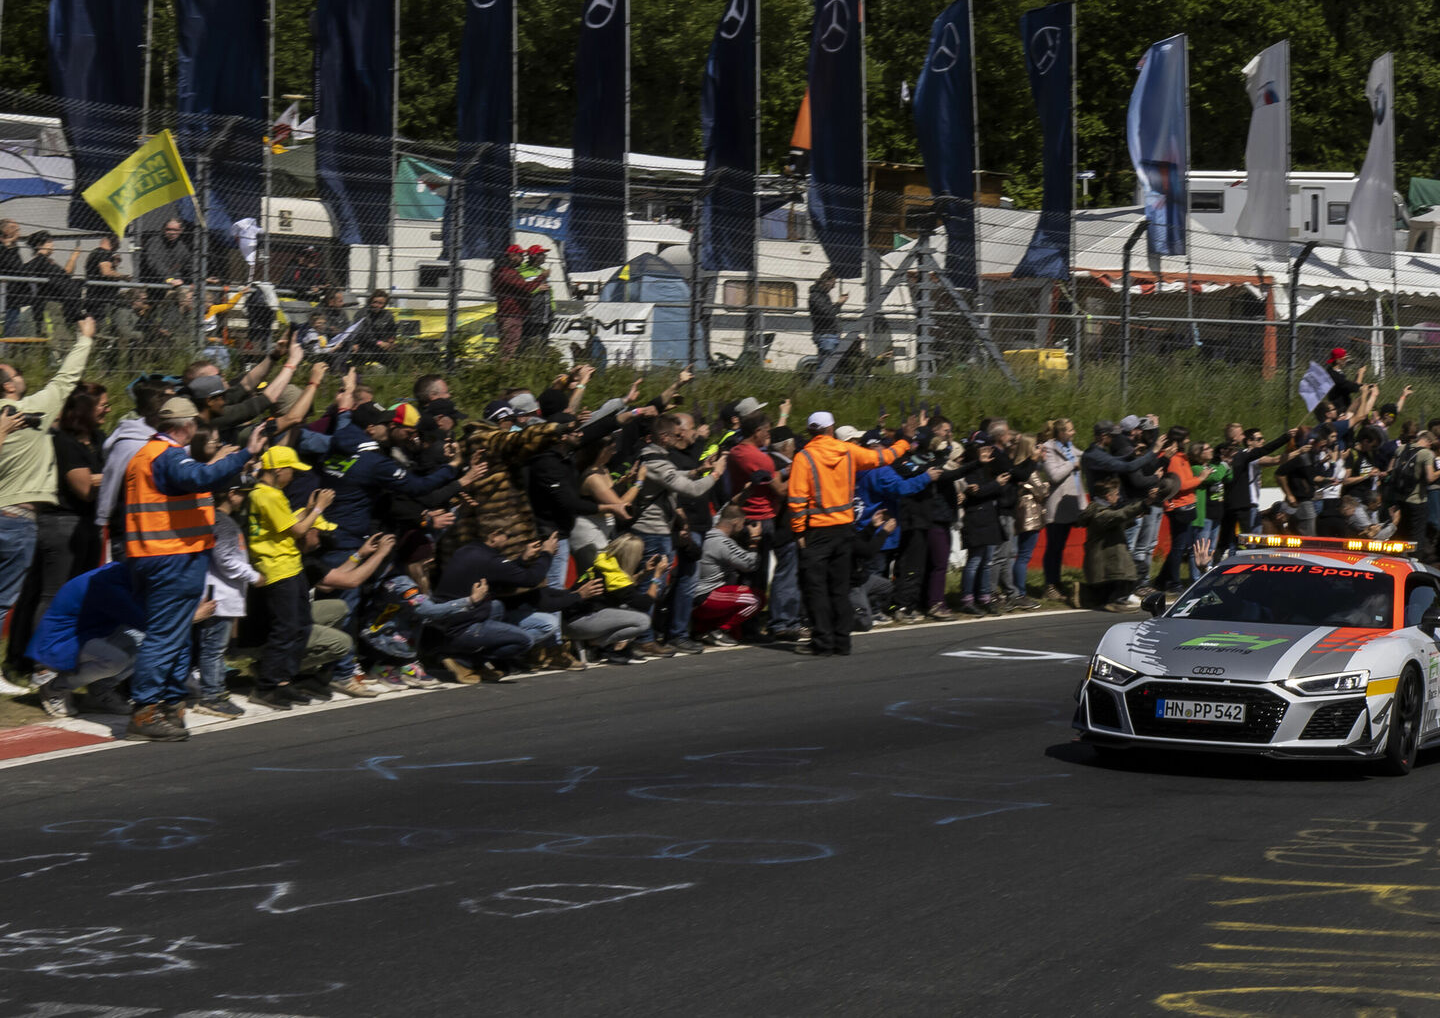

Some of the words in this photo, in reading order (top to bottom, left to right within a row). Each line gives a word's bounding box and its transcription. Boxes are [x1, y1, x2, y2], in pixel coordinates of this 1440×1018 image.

[1251, 564, 1302, 573] Audi
[1308, 565, 1375, 580] Sport
[1165, 701, 1184, 717] HN
[1193, 703, 1212, 719] PP
[1215, 704, 1243, 720] 542
